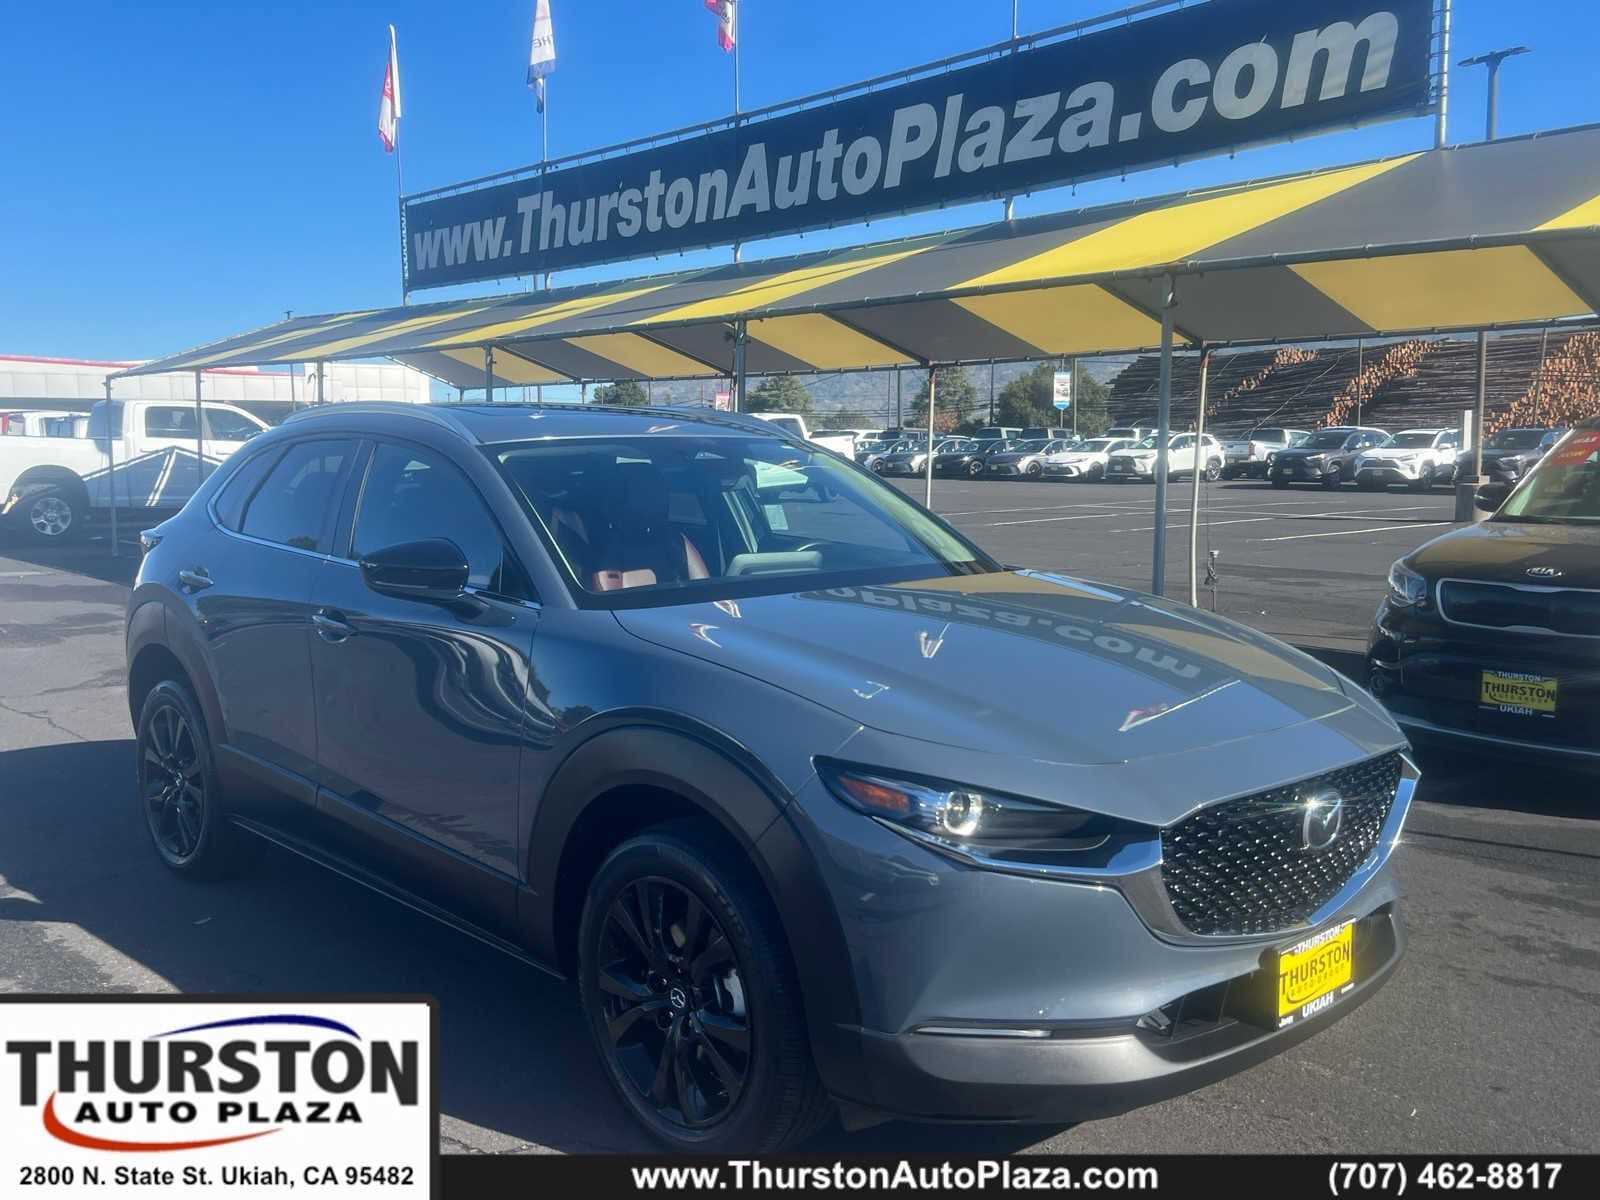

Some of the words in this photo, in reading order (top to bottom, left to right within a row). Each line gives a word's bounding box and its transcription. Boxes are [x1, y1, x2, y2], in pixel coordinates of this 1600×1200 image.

[414, 12, 1399, 271] www.ThurstonAutoPlaza.com
[1529, 567, 1556, 577] KIA
[1497, 671, 1541, 682] THURSTON
[1484, 682, 1556, 702] THURSTON
[1499, 704, 1533, 716] UKIAH
[1298, 924, 1342, 953] THURSTON
[1280, 940, 1350, 995] THURSTON
[1302, 990, 1334, 1018] UKIAH
